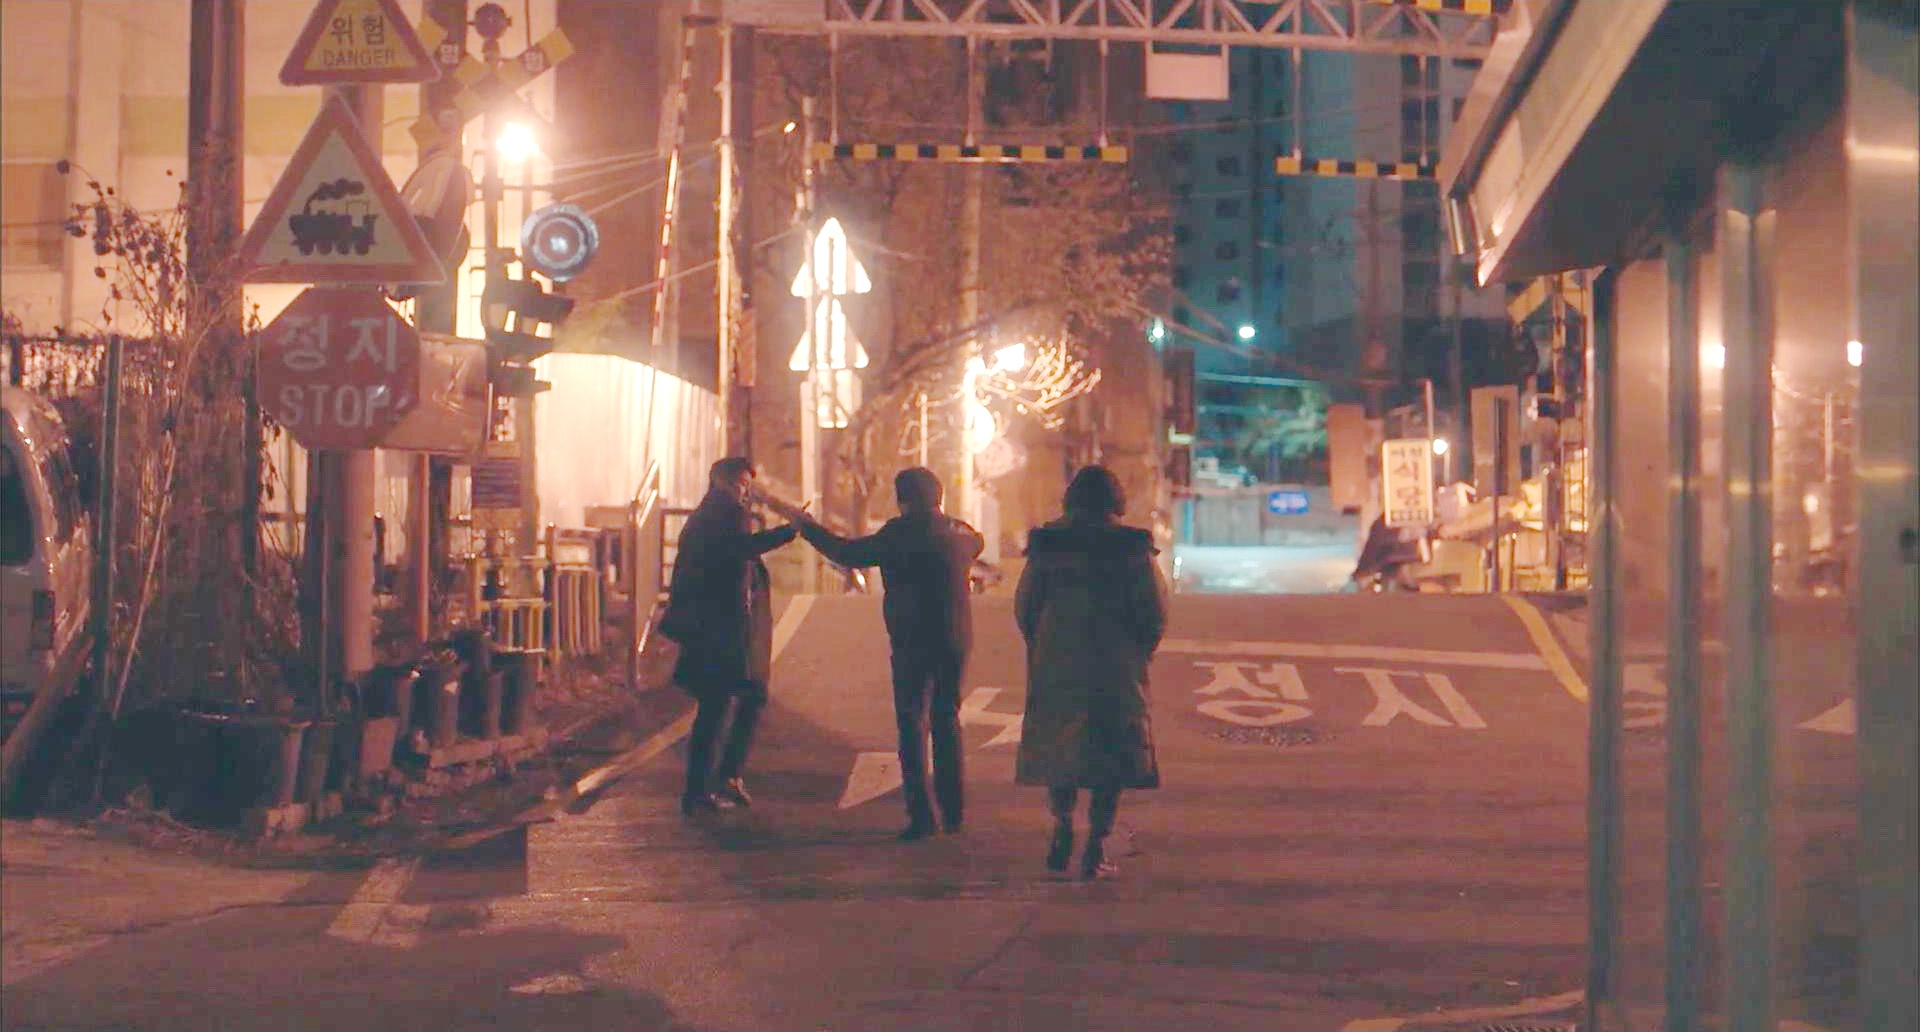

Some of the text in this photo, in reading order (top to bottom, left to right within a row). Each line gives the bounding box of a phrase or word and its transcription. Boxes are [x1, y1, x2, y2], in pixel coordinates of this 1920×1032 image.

[330, 14, 385, 46] 위험
[322, 48, 396, 67] DANGER
[277, 313, 397, 373] 정지
[279, 383, 392, 428] STOP
[1192, 661, 1488, 729] 정지
